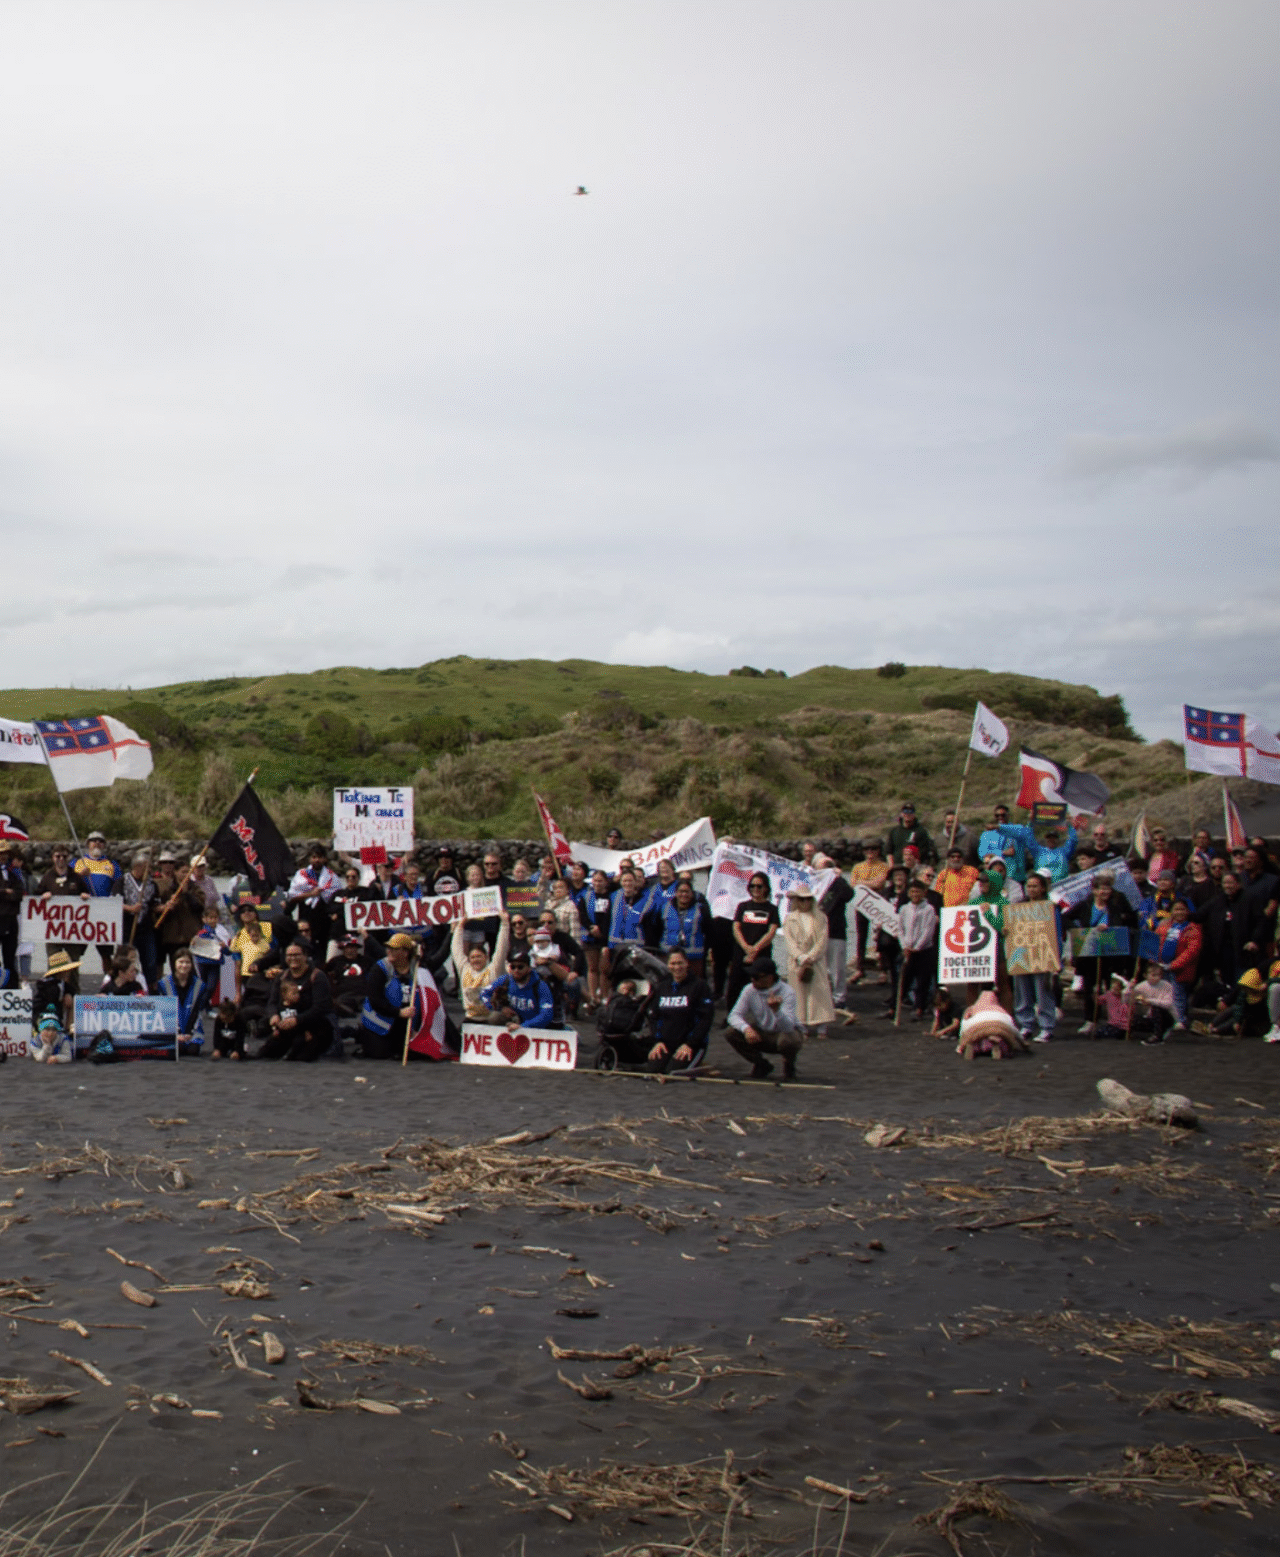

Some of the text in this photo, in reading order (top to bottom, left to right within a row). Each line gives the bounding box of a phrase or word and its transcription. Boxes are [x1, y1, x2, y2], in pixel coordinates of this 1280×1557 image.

[628, 837, 676, 866] BAN
[28, 899, 90, 921] Mana
[45, 921, 116, 942] MAORI
[944, 956, 990, 967] TOGETHER
[2, 991, 32, 1012] Seas
[83, 1011, 165, 1032] IN PATEA
[463, 1033, 492, 1056] WE
